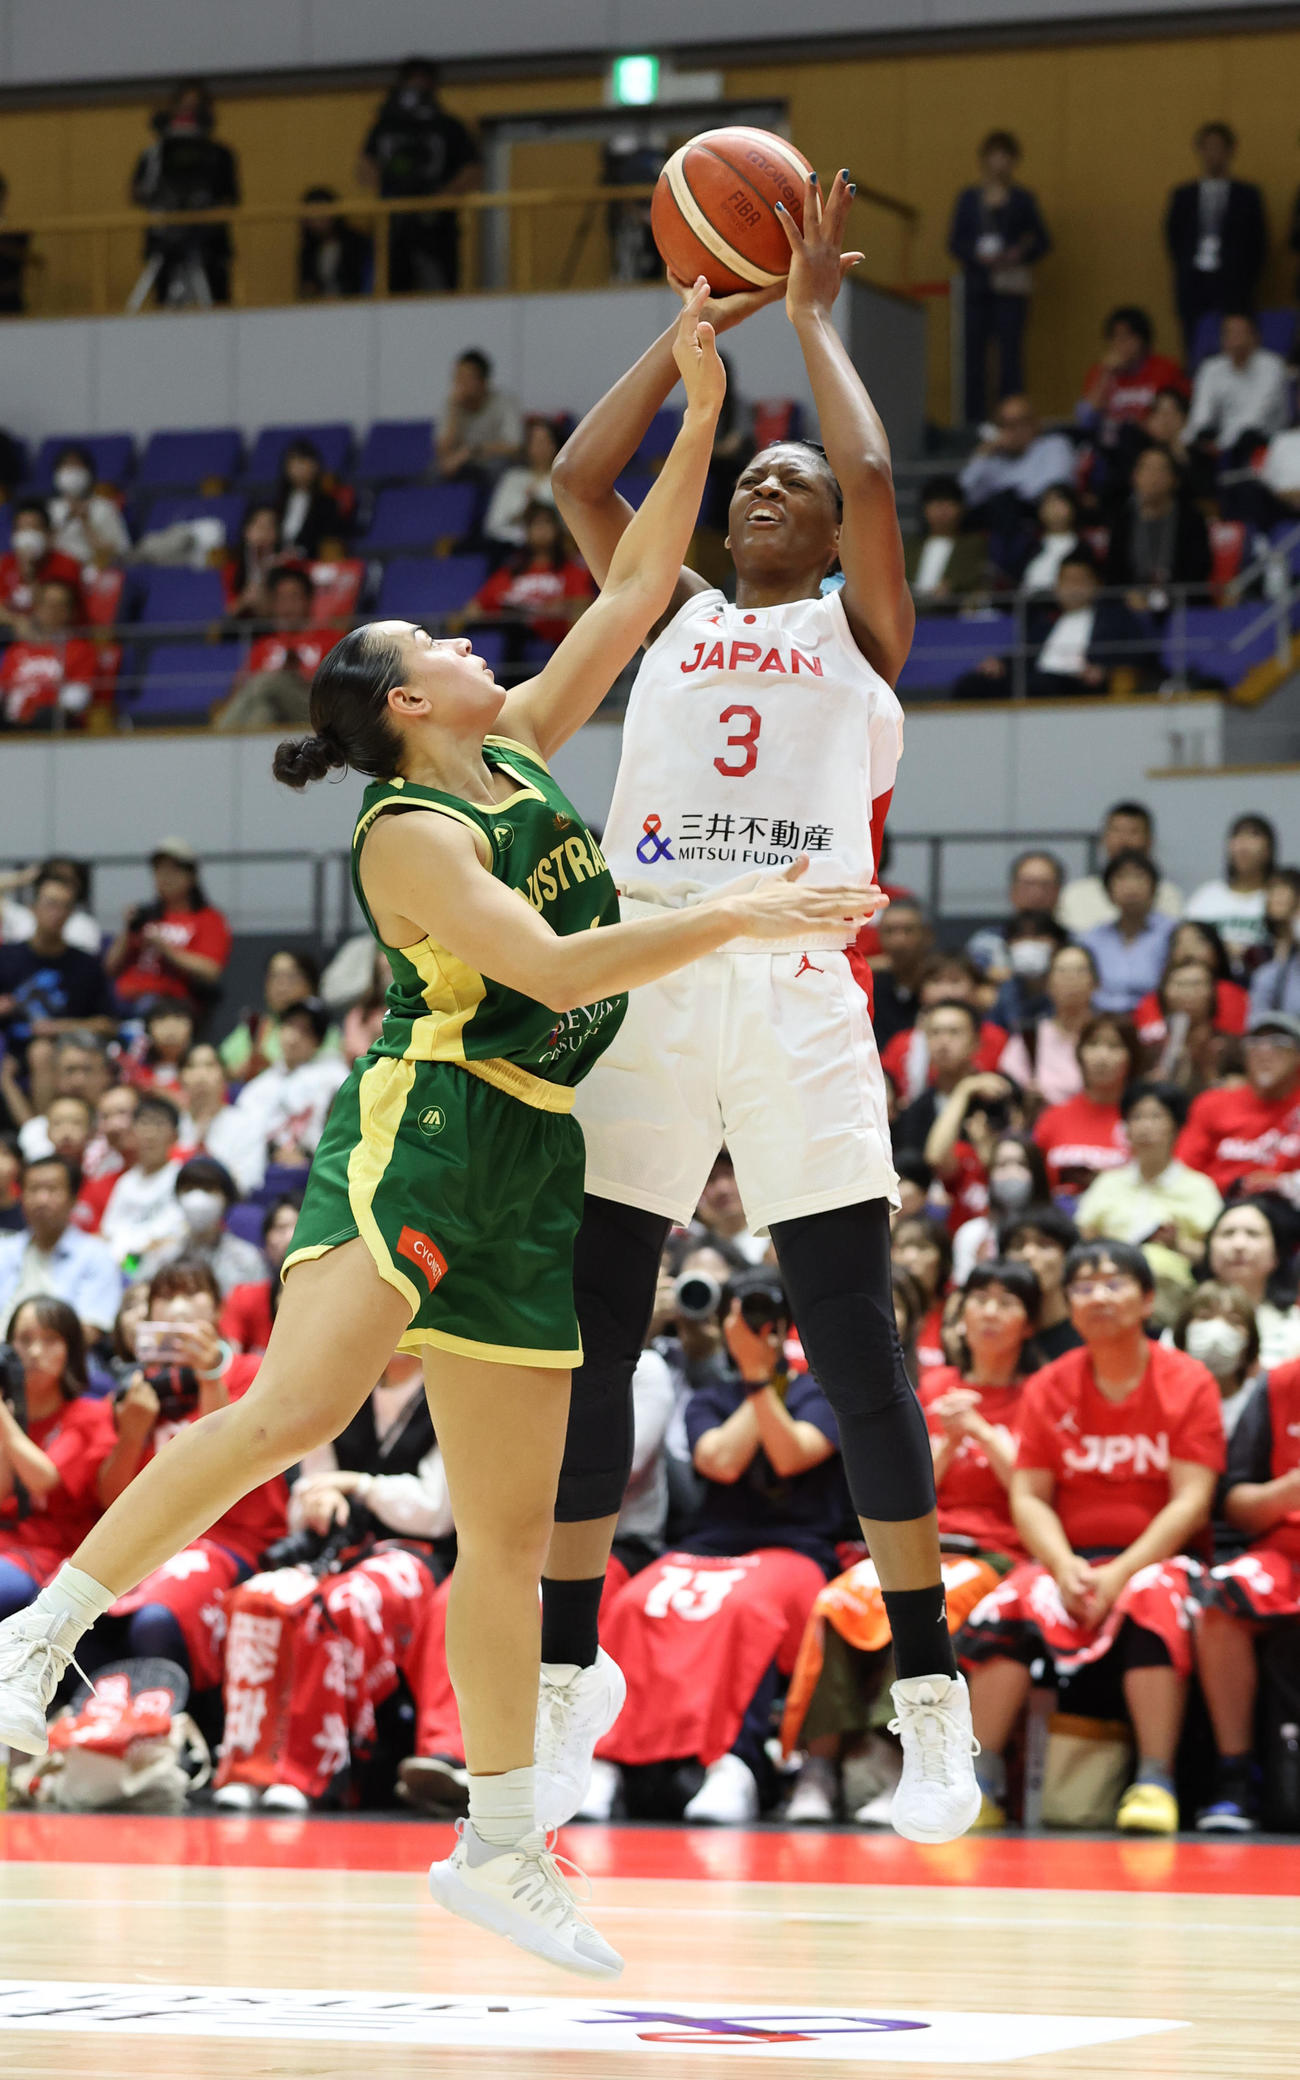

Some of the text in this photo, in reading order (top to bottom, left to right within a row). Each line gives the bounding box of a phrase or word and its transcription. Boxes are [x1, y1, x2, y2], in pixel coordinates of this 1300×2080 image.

[746, 151, 801, 213] molten
[728, 189, 761, 227] FIBA
[680, 640, 824, 677] JAPAN
[713, 704, 762, 778] 3
[679, 812, 834, 851] 三井不動産
[678, 846, 799, 866] MITSUI FUDO
[413, 1240, 442, 1283] CYGNETT
[1062, 1430, 1169, 1475] JPN
